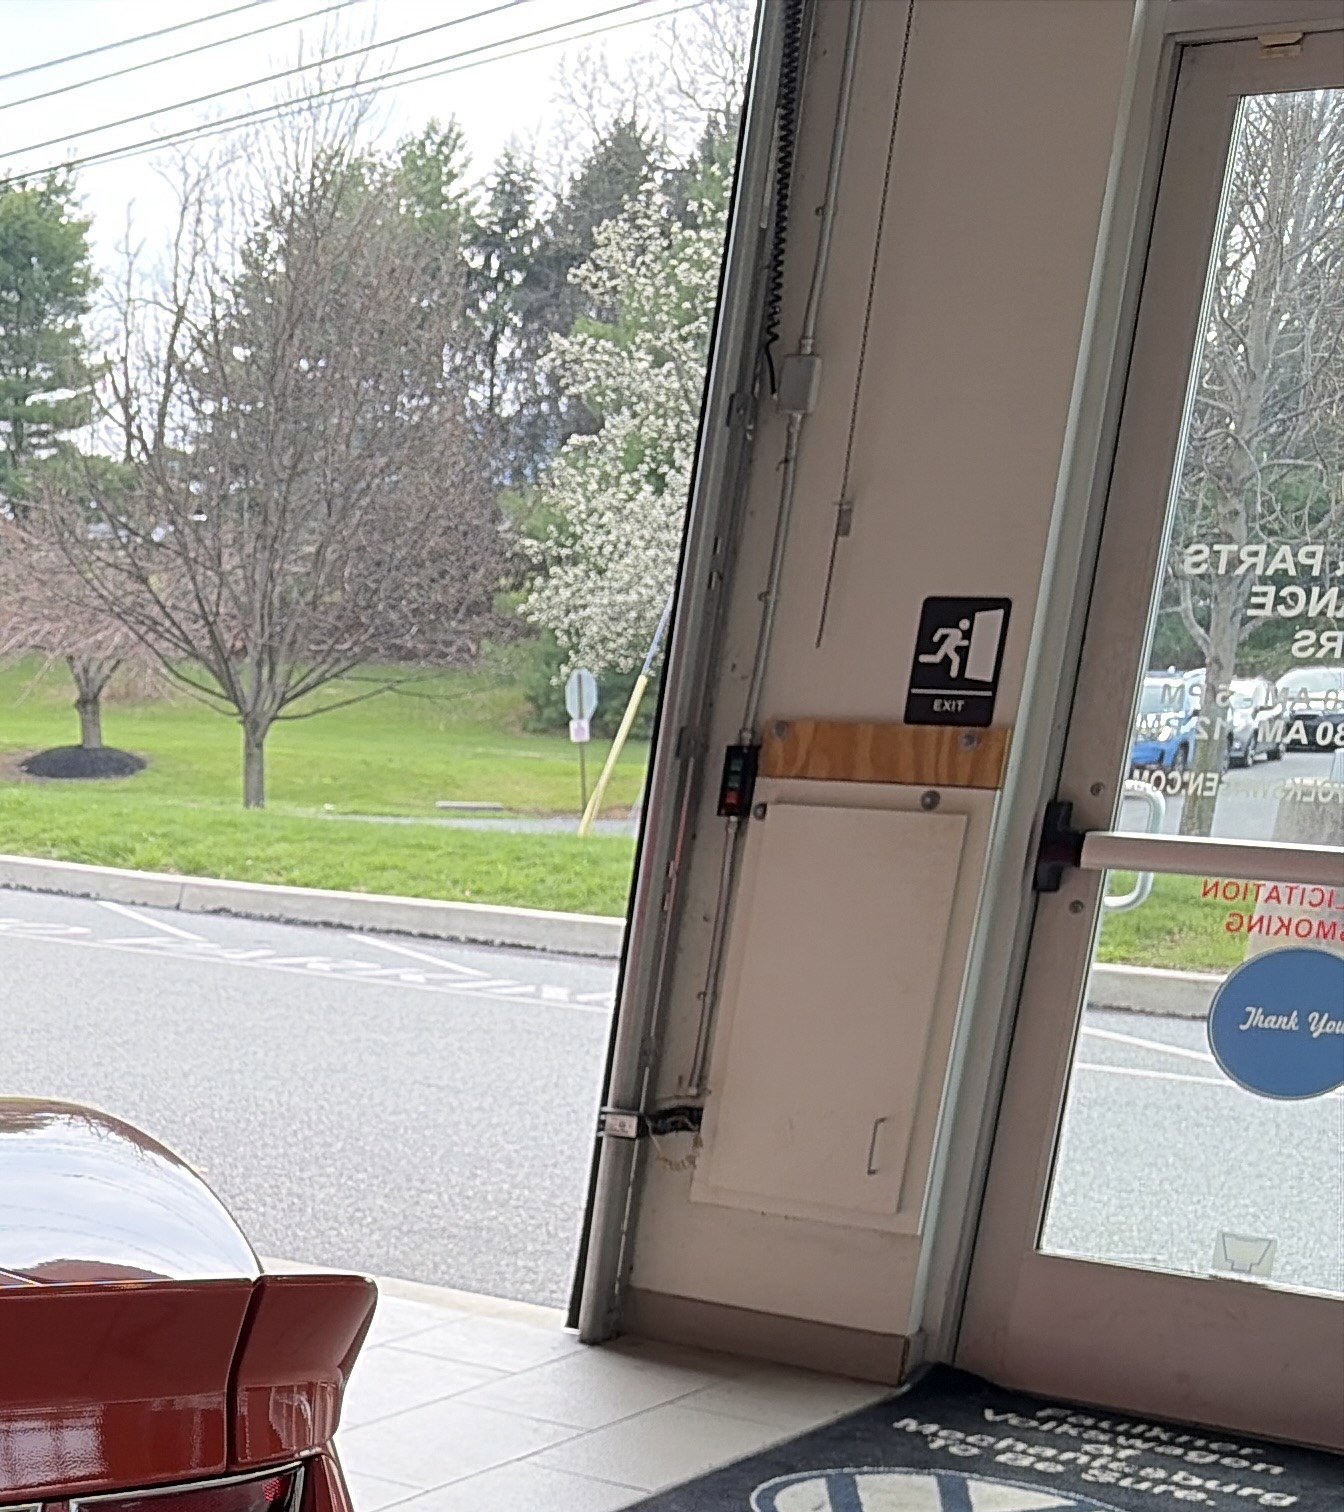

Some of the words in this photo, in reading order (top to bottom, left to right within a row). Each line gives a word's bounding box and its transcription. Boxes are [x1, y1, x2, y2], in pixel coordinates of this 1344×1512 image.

[933, 698, 965, 712] EXIT
[1239, 1006, 1299, 1032] Thank
[984, 1407, 1285, 1475] Volkswagen
